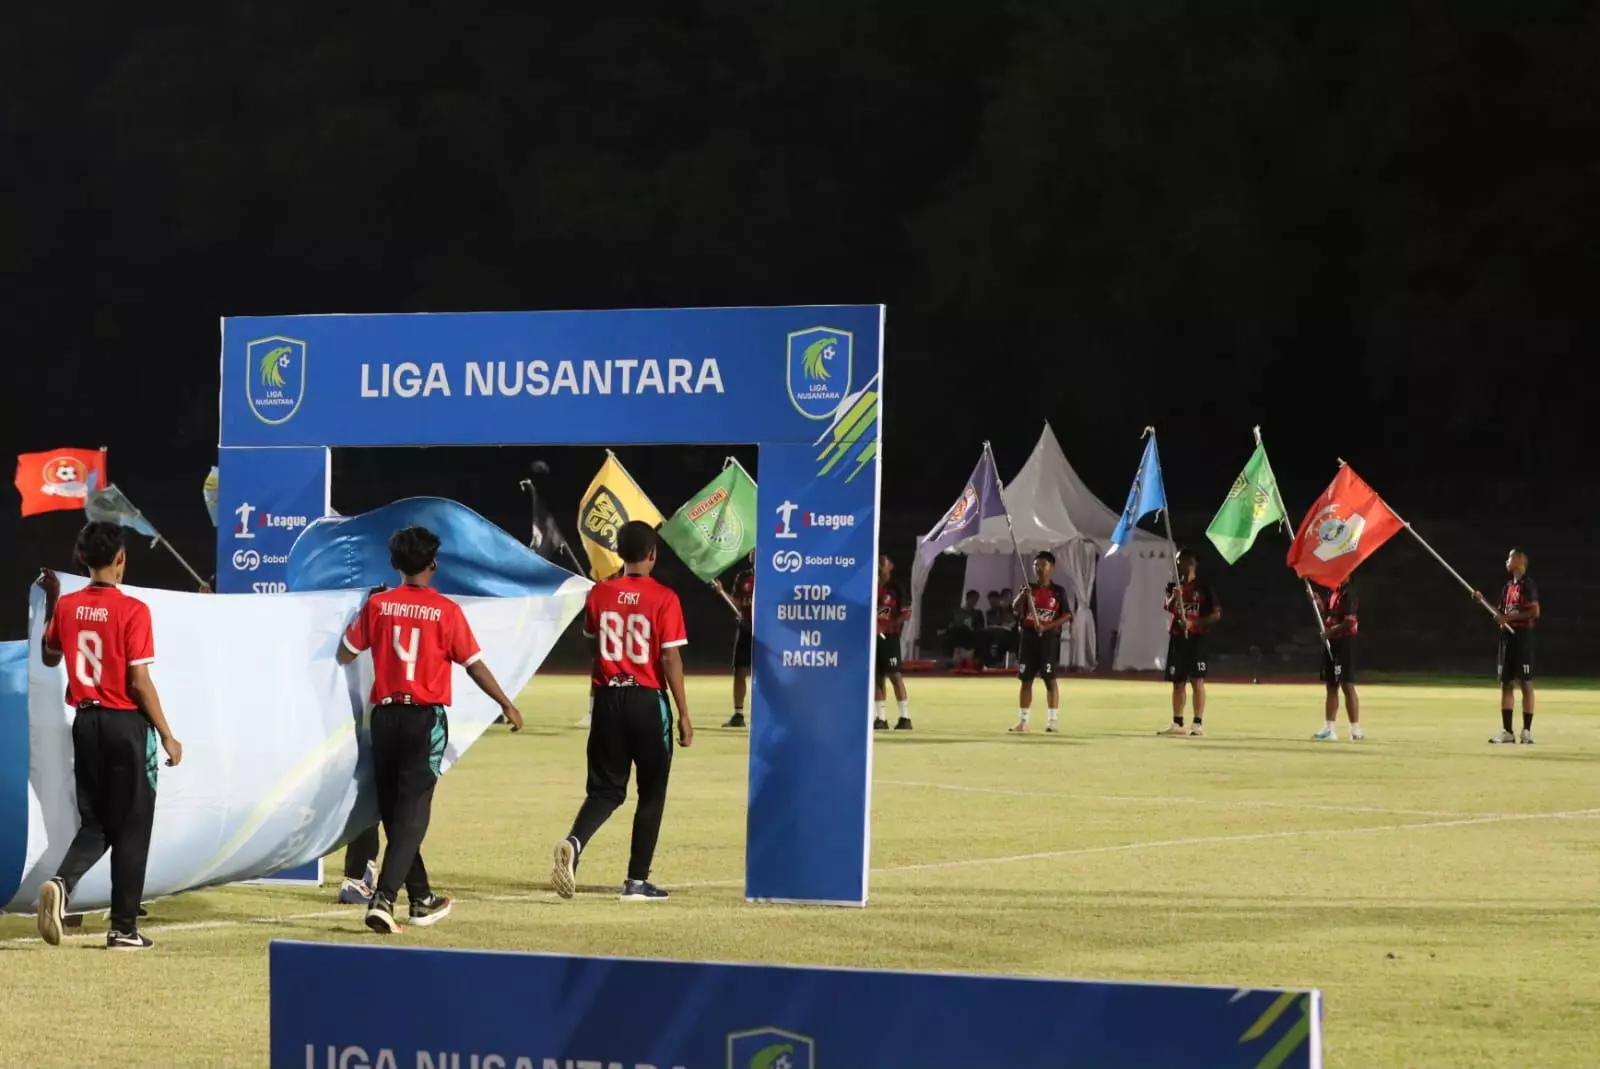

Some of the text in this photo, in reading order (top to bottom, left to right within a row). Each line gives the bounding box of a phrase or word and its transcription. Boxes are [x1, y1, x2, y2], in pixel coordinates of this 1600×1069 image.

[361, 358, 725, 398] LIGA NUSANTARA
[805, 556, 856, 568] Sobat Liga
[617, 591, 640, 605] ZAKI
[794, 584, 832, 601] STOP
[76, 605, 109, 622] ATHAR
[777, 605, 847, 621] BULLYING
[600, 611, 651, 664] 88
[800, 630, 822, 647] NO
[76, 630, 103, 687] 8
[393, 625, 420, 681] 4
[782, 651, 839, 668] RACISM
[1197, 661, 1206, 672] 13
[1523, 663, 1530, 674] 11
